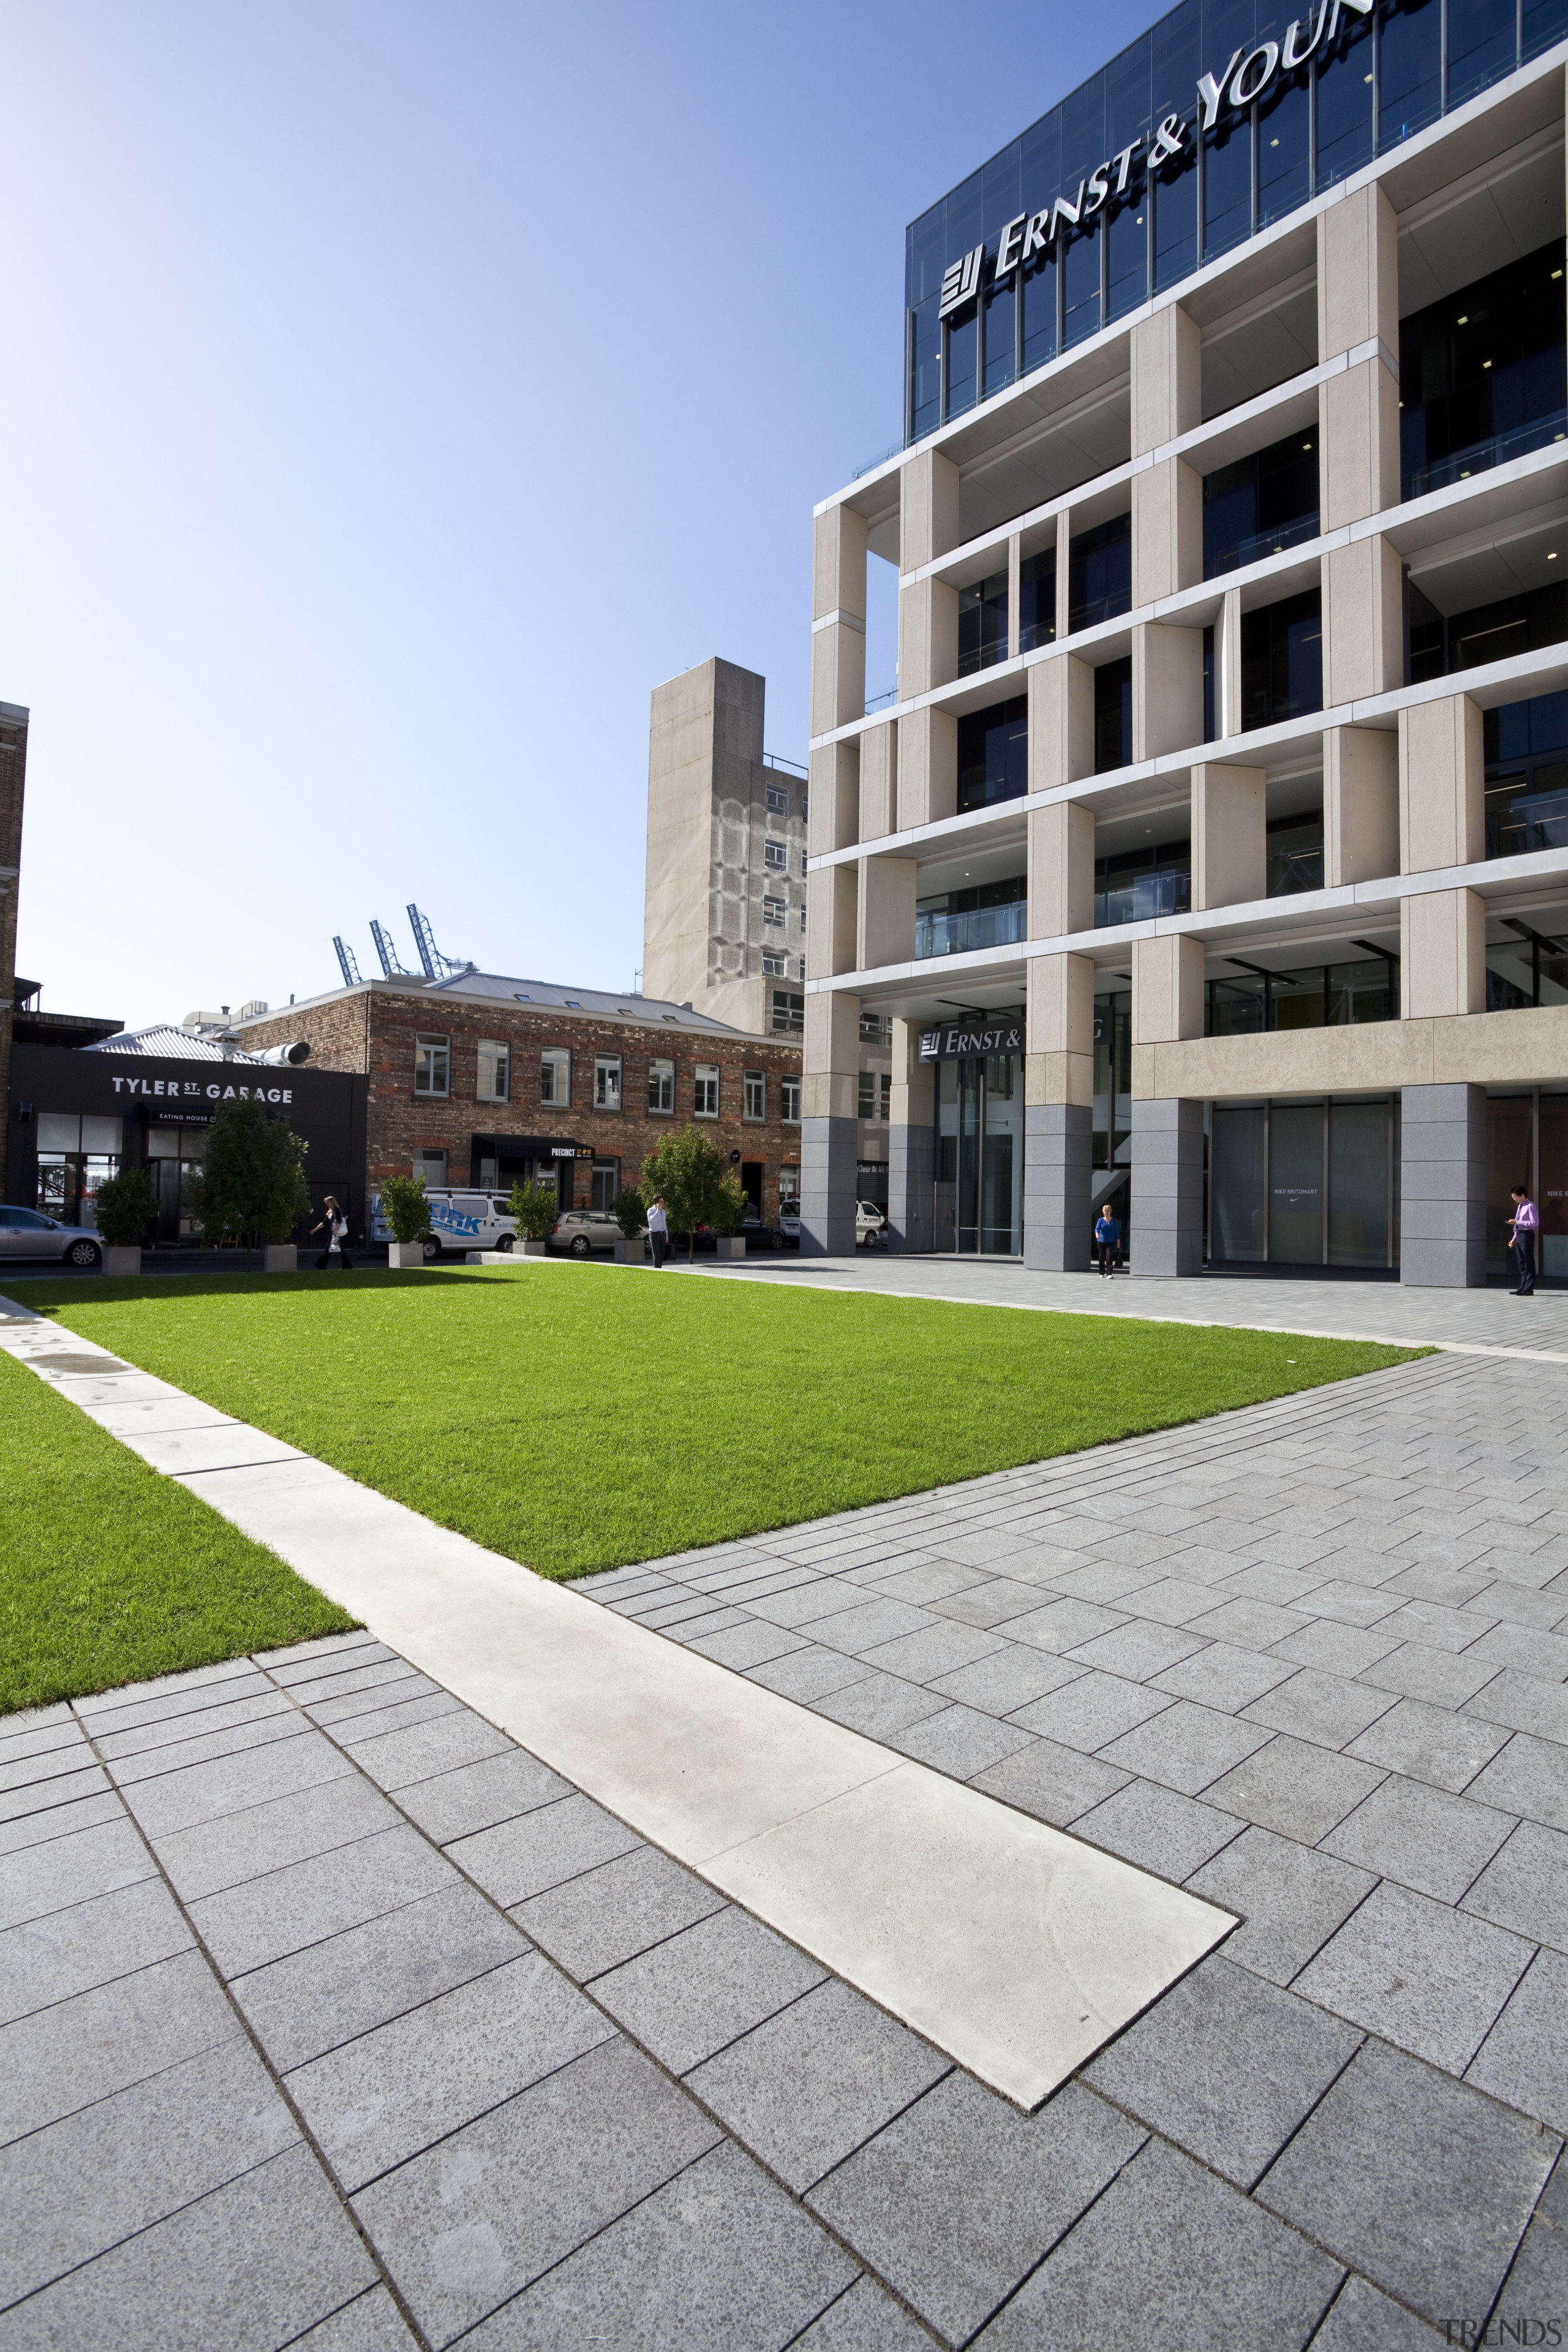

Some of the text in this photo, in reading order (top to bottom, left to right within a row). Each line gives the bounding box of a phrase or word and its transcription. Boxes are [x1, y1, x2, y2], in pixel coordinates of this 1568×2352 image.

[995, 138, 1142, 280] ERNST
[1147, 113, 1186, 168] &
[946, 1030, 1004, 1053] ERNST
[1006, 1029, 1020, 1047] &
[112, 1077, 293, 1104] TYLER ST. GARAGE
[552, 1148, 575, 1157] PRECINCT
[858, 1164, 871, 1173] Clear
[426, 1201, 483, 1235] KIRK
